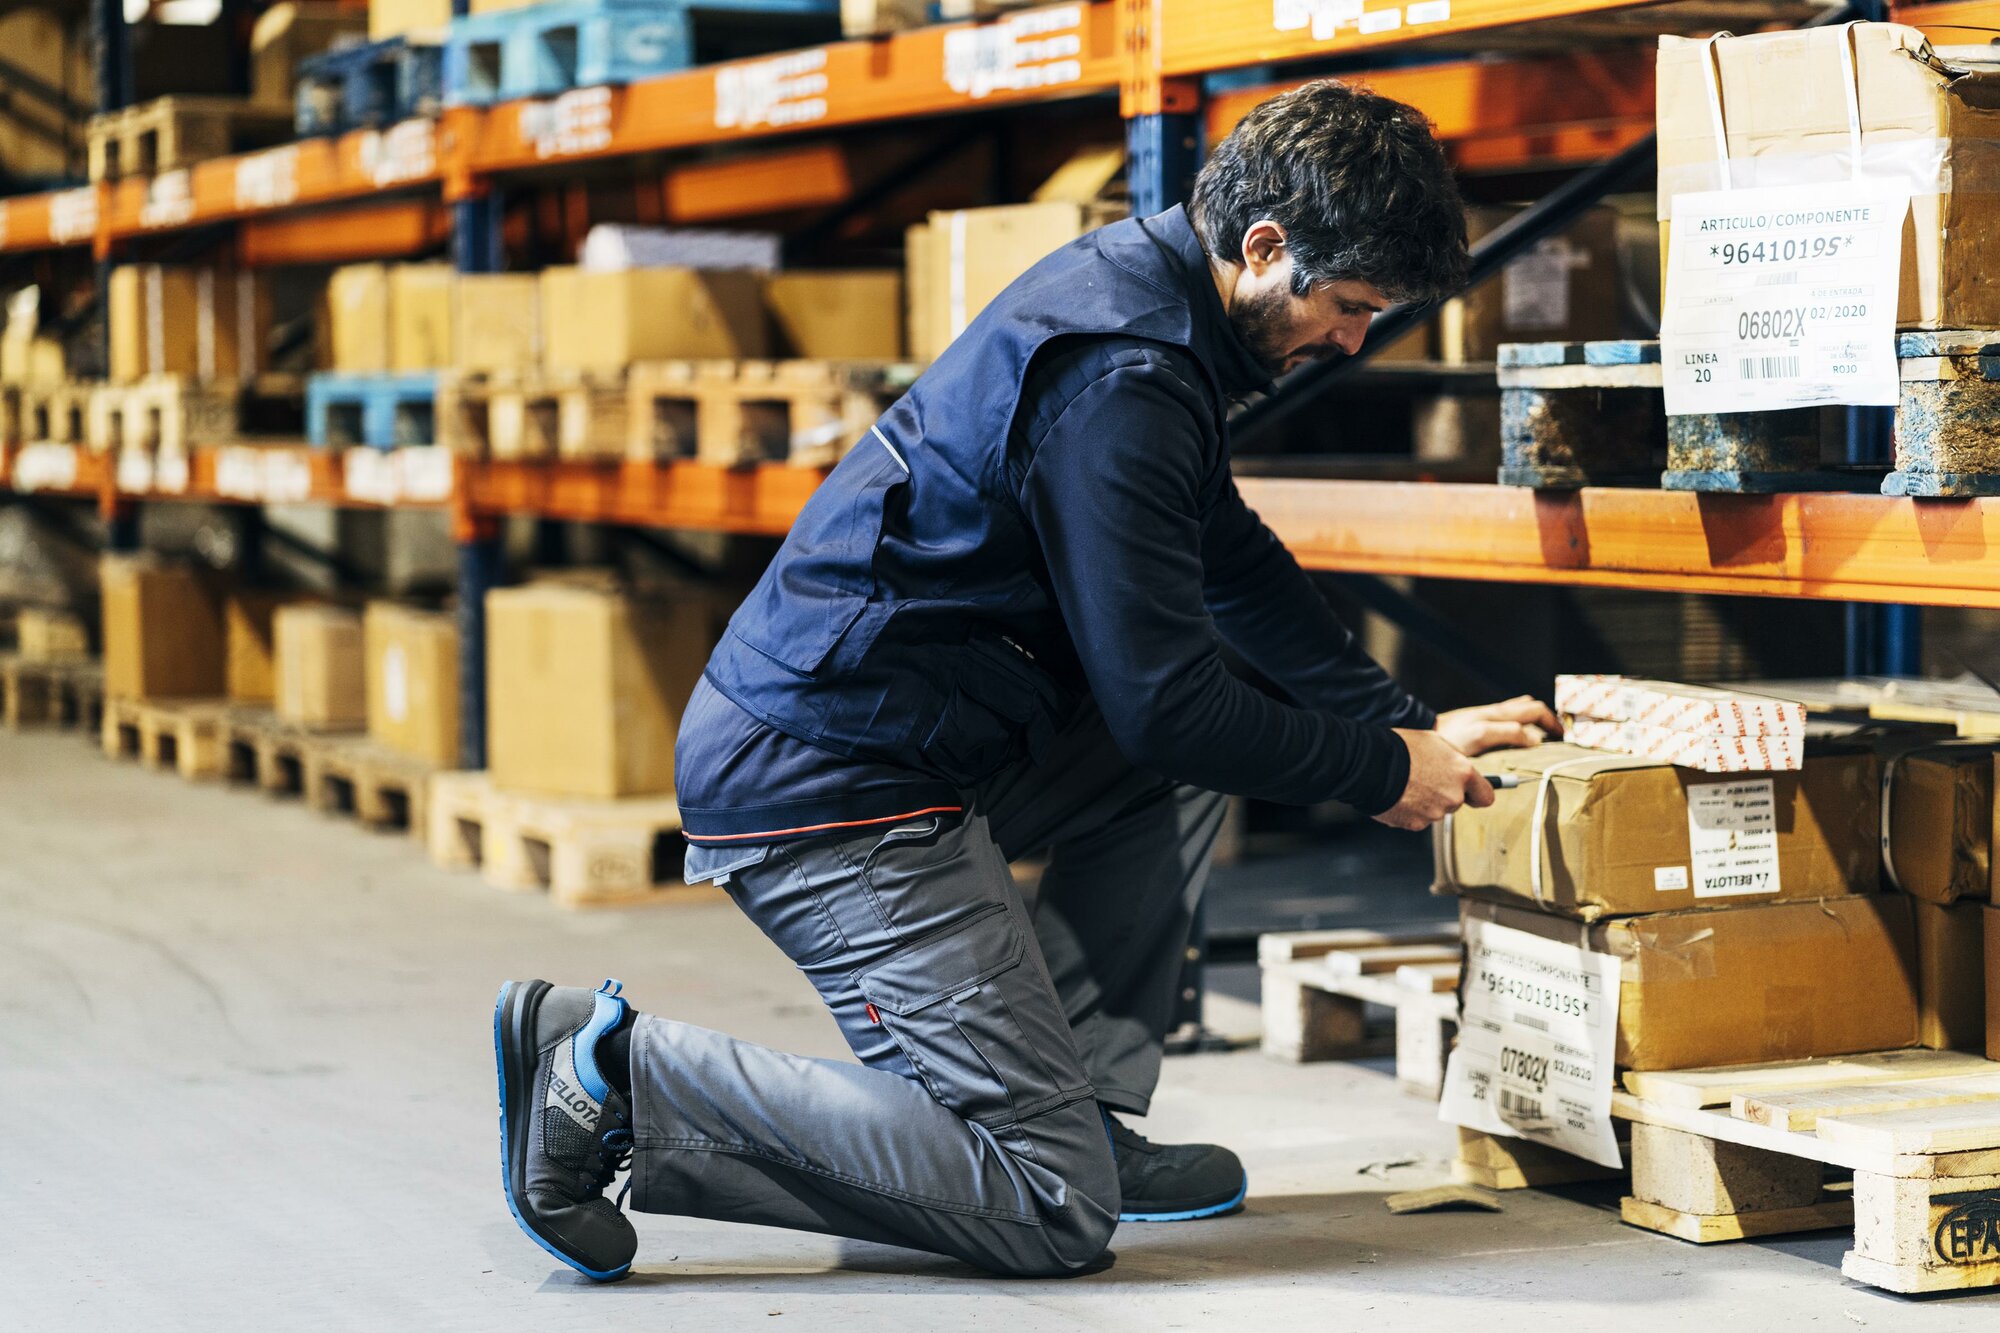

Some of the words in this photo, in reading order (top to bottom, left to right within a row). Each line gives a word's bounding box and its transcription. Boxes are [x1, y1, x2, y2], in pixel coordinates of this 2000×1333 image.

[1700, 208, 1870, 232] ARTICULO/COMPONENTE
[1810, 304, 1867, 321] 02/2020
[1738, 307, 1806, 341] 06802X
[1685, 353, 1719, 366] LINEA
[1694, 369, 1712, 383] 20
[1832, 365, 1858, 374] ROJO
[1705, 874, 1753, 889] BELLOTA
[1500, 1046, 1549, 1086] 07802X
